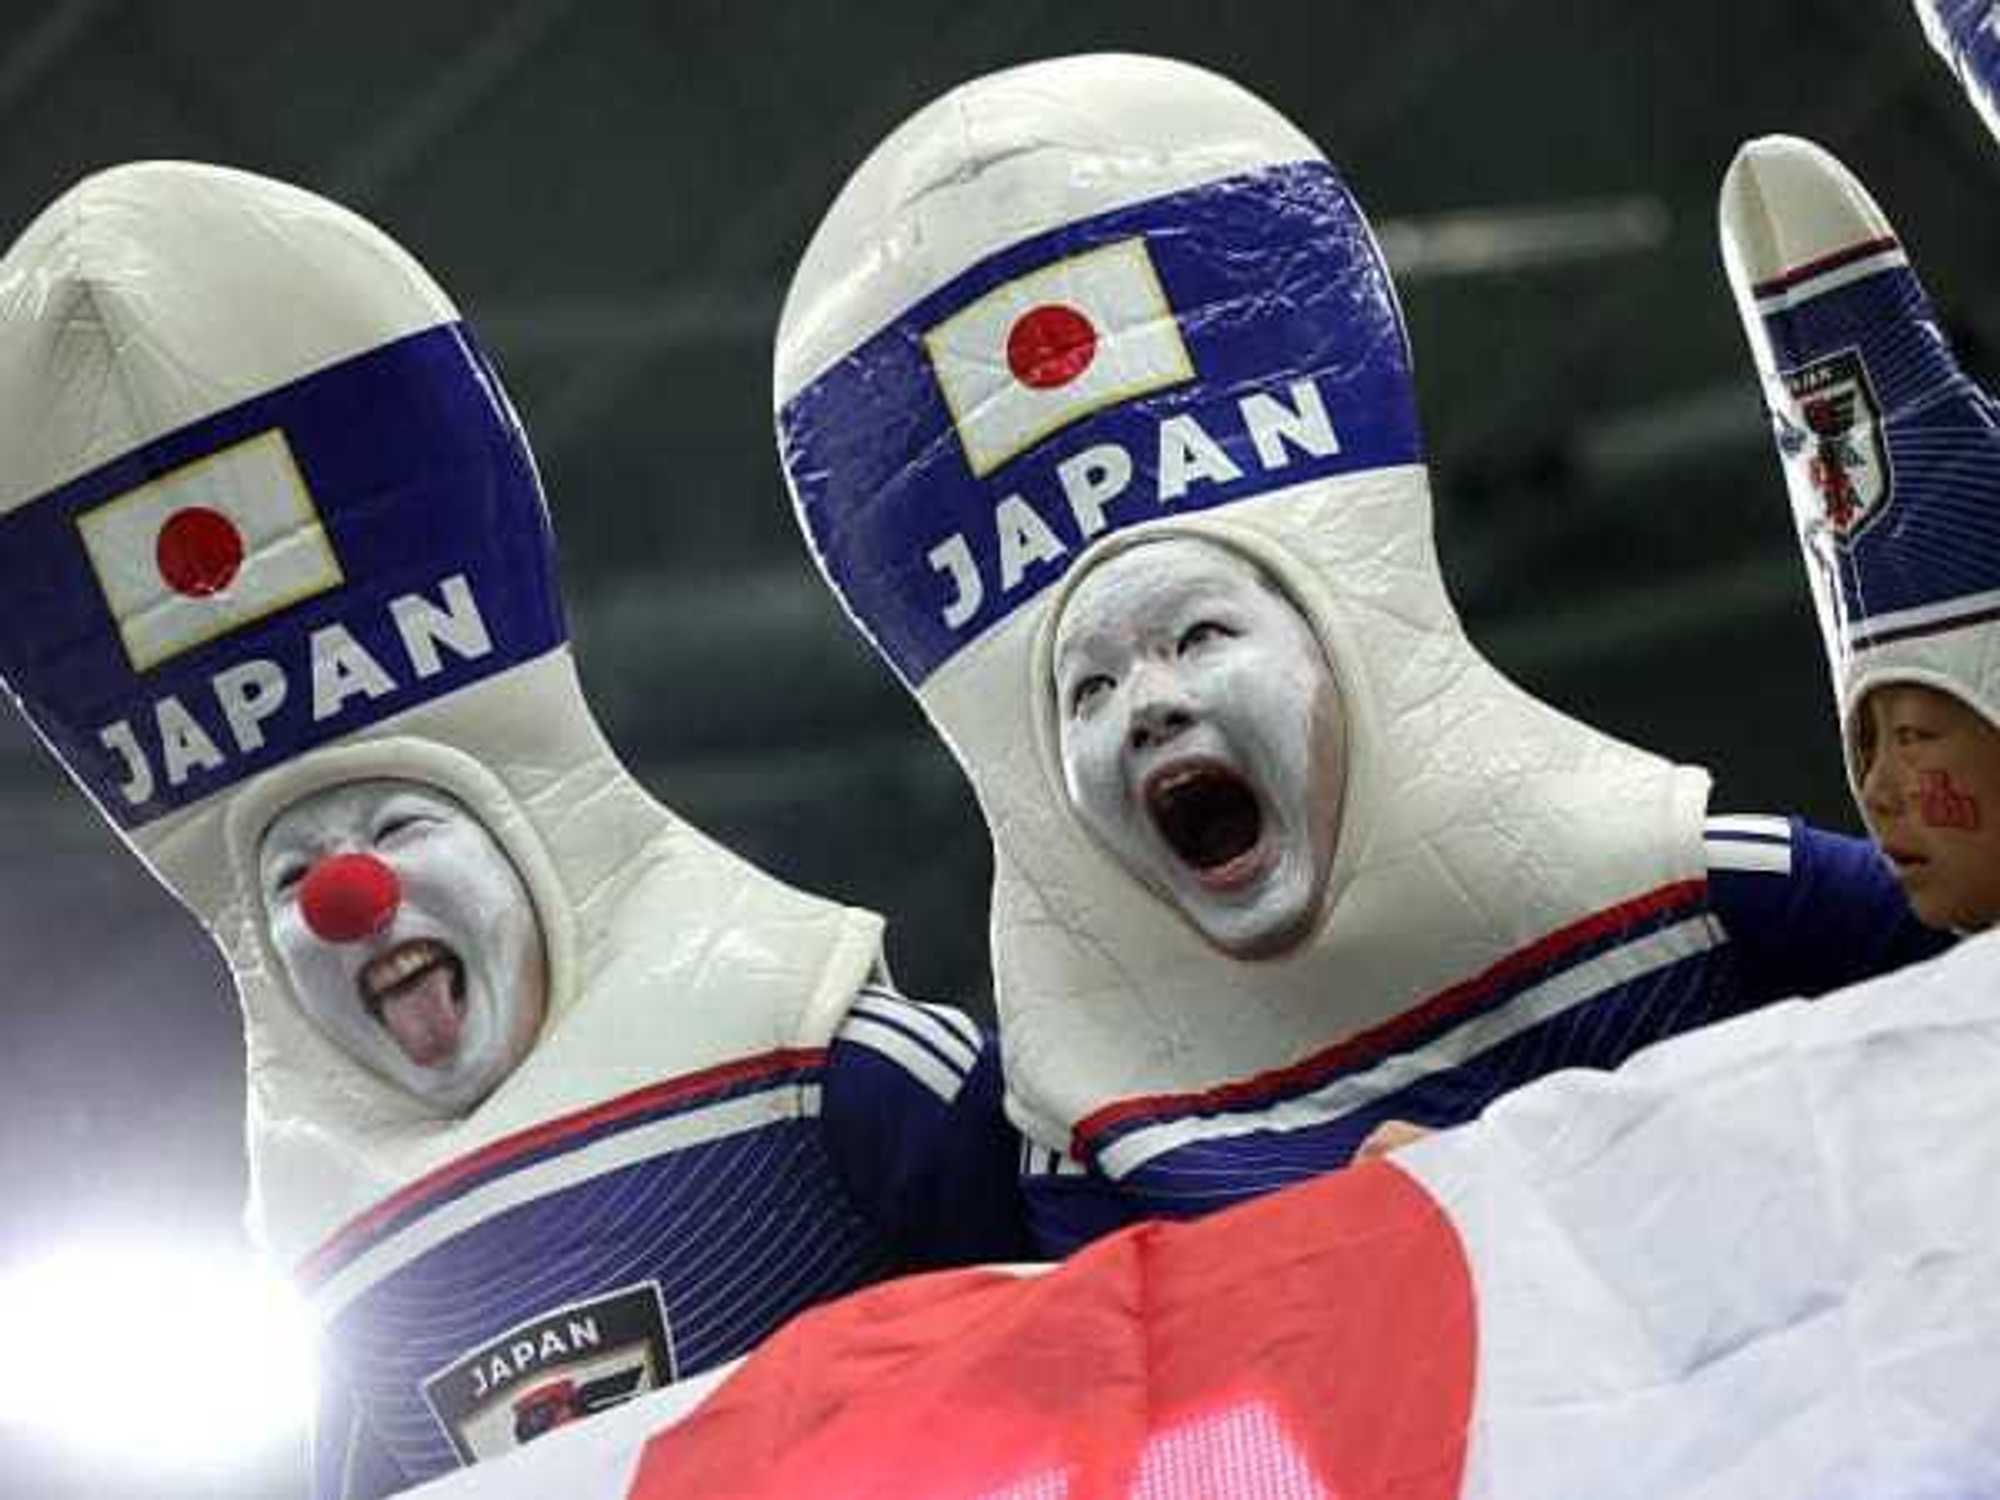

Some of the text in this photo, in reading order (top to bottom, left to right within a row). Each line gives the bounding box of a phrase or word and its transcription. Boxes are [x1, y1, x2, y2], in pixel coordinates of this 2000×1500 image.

[927, 379, 1340, 630] JAPAN
[100, 574, 493, 804] JAPAN
[470, 1317, 600, 1397] JAPAN
